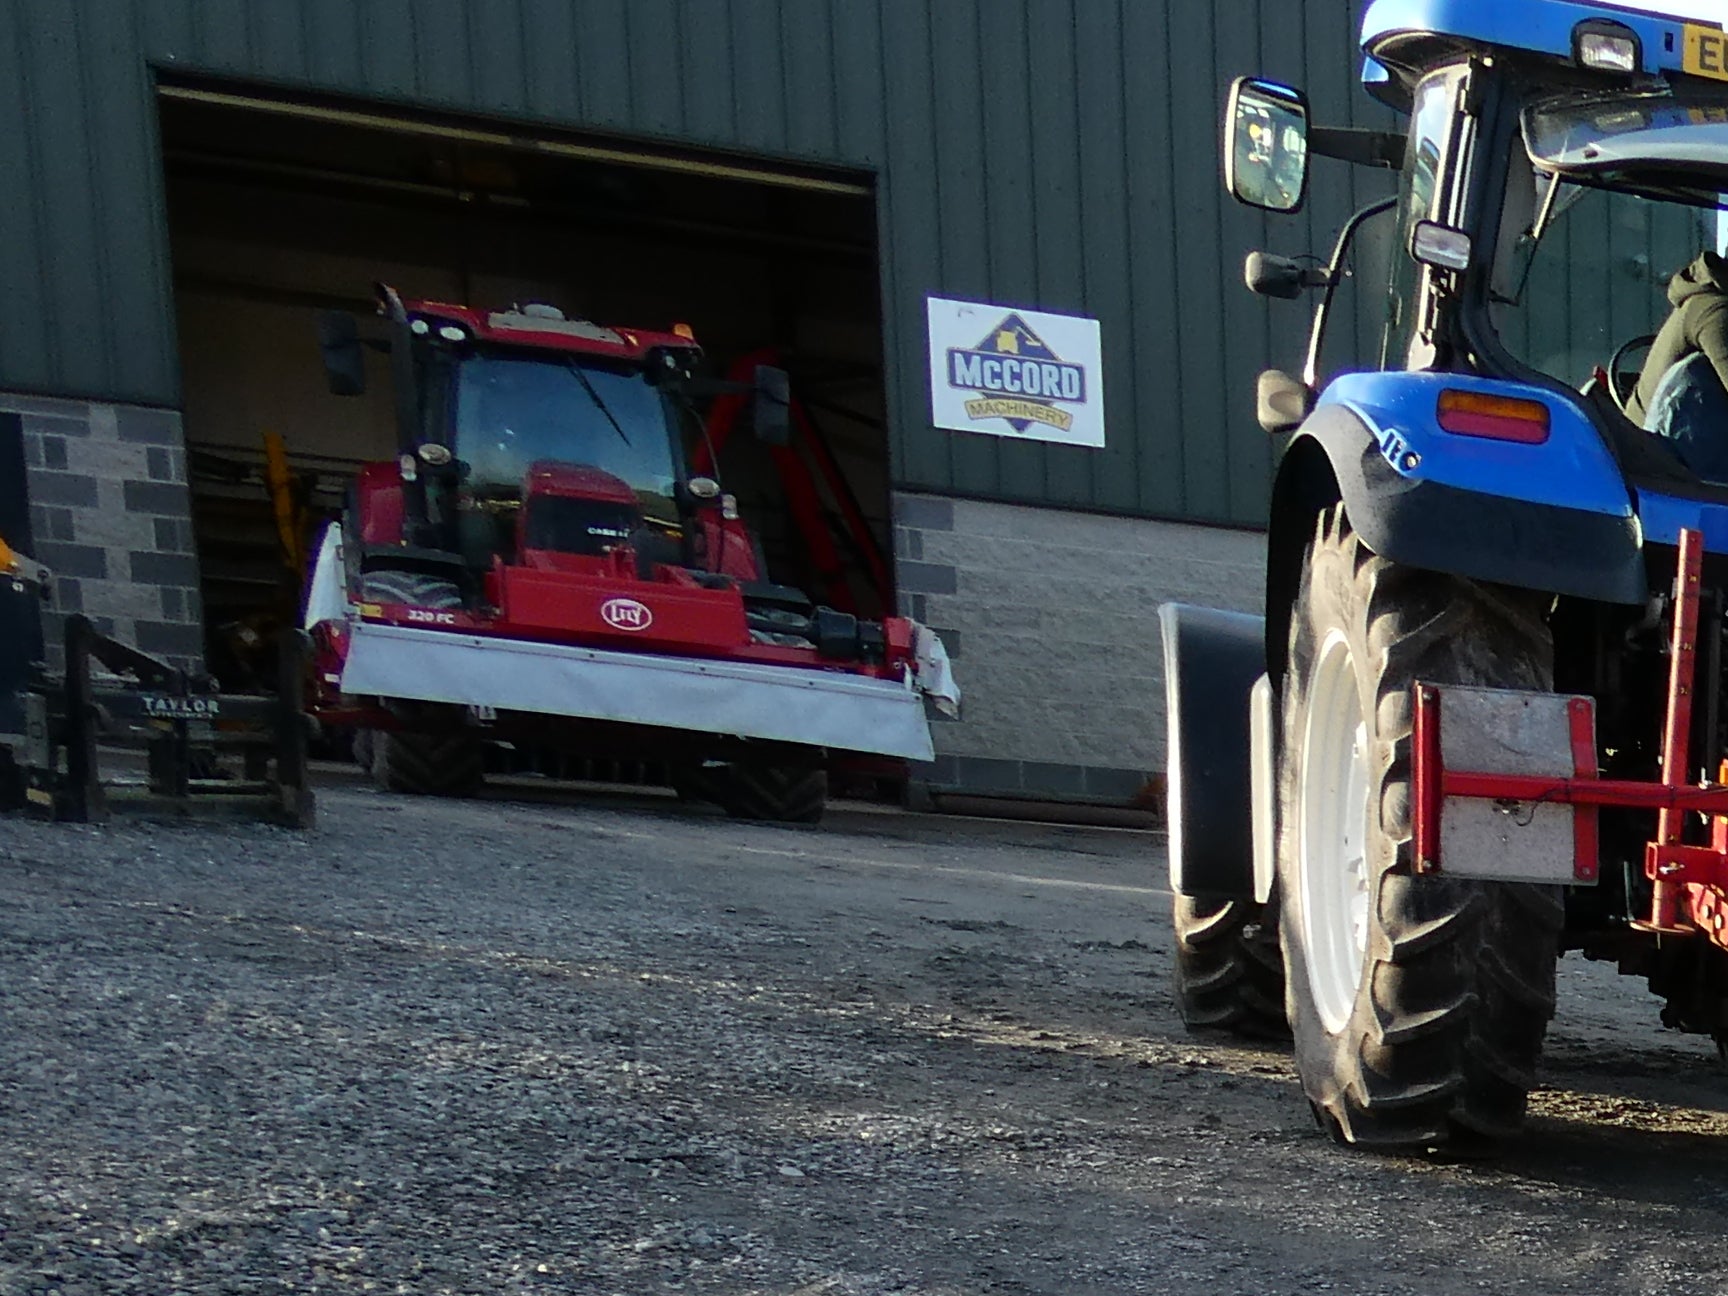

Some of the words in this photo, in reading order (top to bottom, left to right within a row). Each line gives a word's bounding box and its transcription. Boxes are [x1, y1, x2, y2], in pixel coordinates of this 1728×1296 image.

[968, 400, 1069, 427] MACHINERY
[436, 612, 454, 625] FC
[142, 697, 220, 713] TAYLOR
